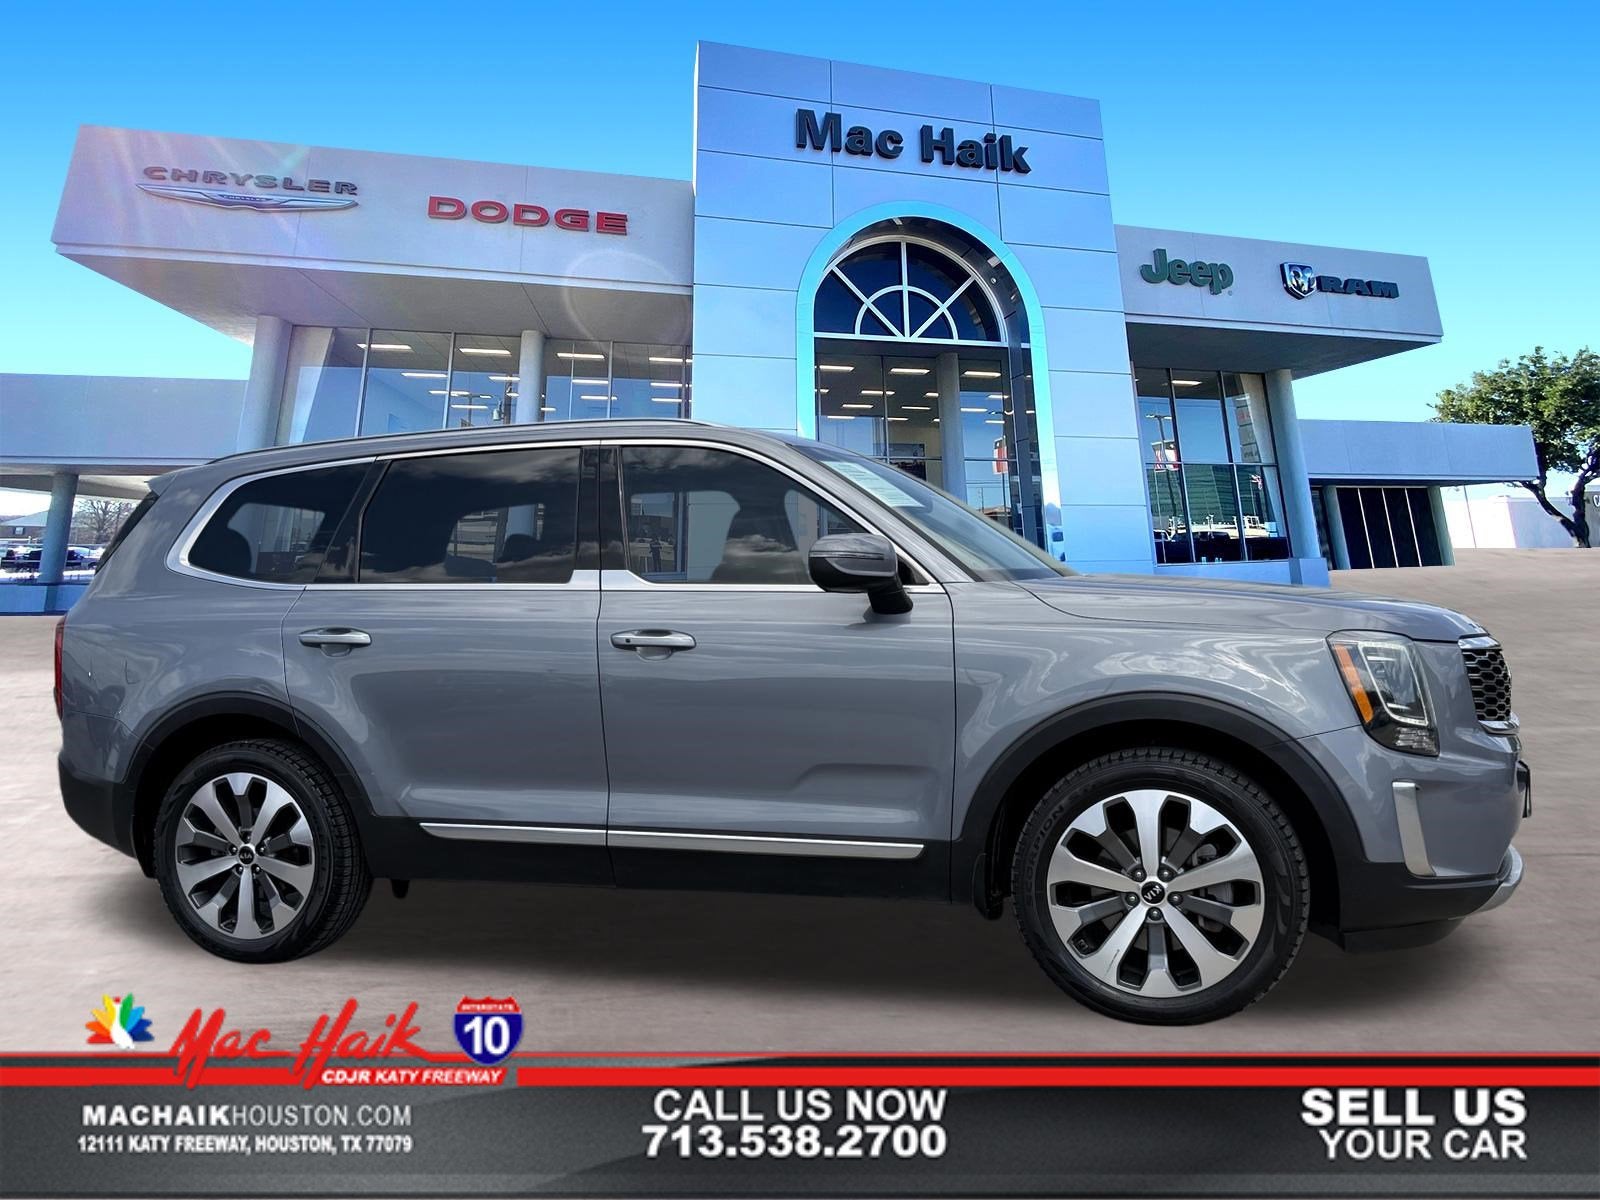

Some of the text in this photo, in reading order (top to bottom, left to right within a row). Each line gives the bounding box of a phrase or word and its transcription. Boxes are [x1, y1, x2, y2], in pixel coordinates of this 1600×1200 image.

[796, 108, 1032, 174] Mac Haik
[143, 166, 358, 196] CHRYSLER
[427, 195, 628, 236] DODGE
[1139, 248, 1234, 295] Jeep
[1316, 275, 1400, 299] RAM
[1144, 885, 1162, 901] KIA
